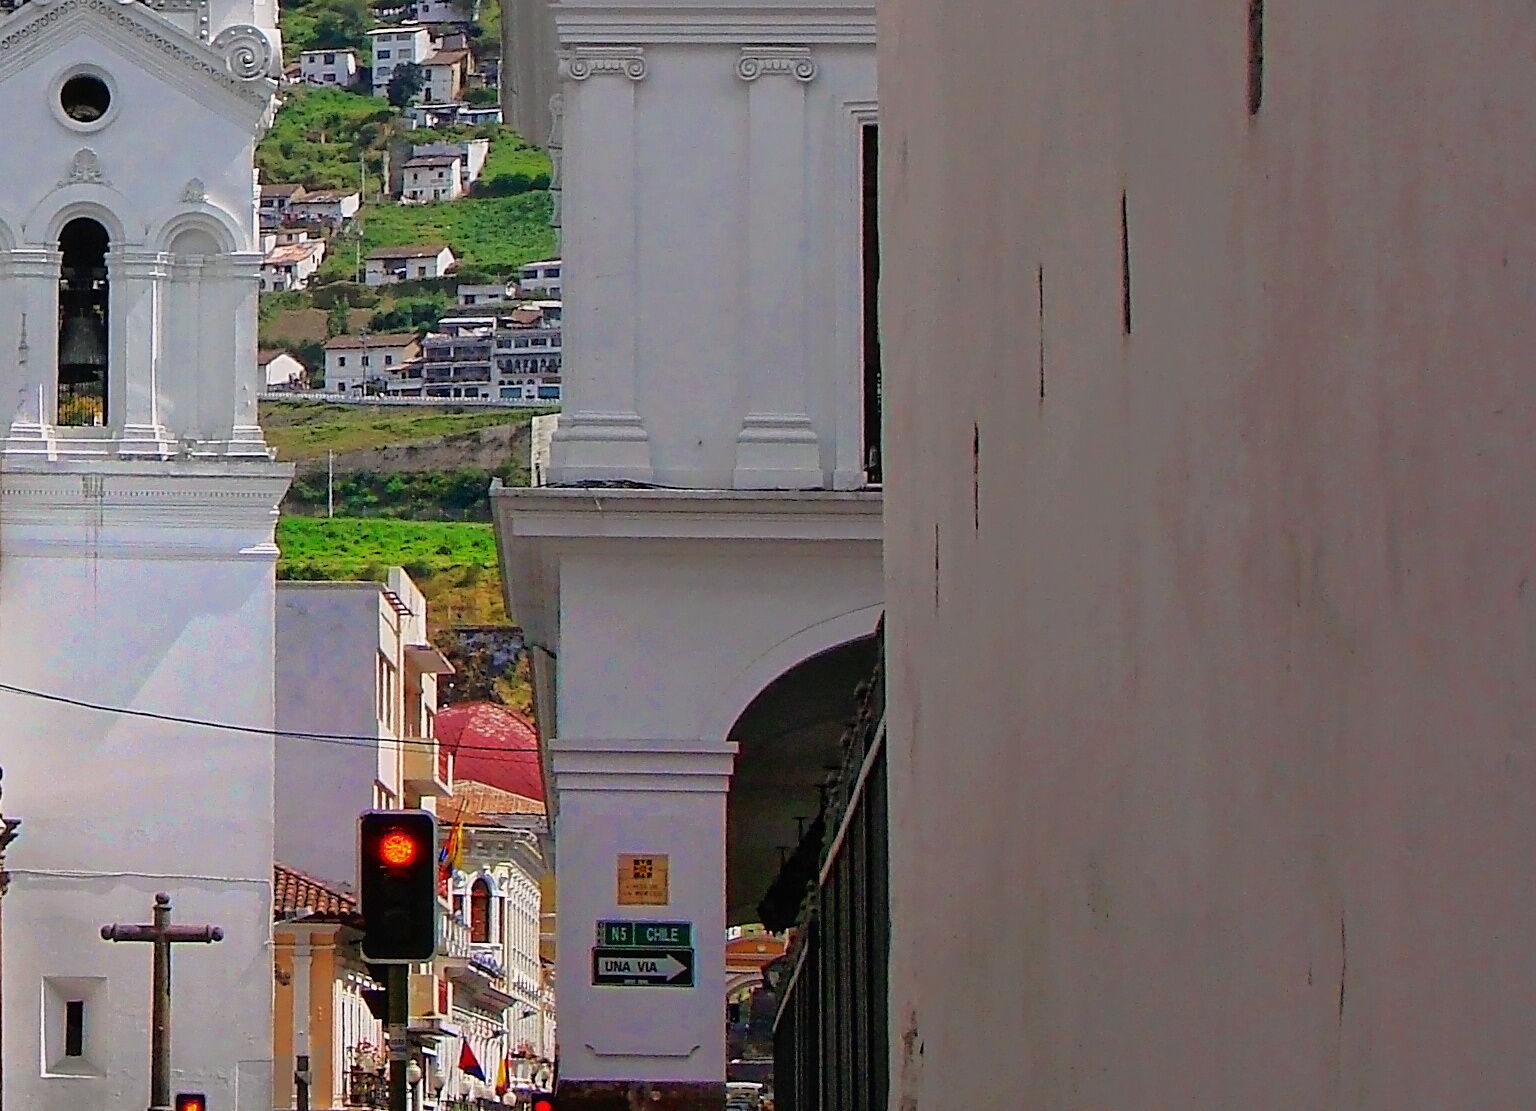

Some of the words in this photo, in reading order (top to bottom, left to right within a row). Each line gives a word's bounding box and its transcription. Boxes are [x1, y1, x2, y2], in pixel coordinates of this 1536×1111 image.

[611, 926, 627, 942] N5
[646, 927, 679, 942] CHILE
[605, 960, 631, 972] UNA
[637, 961, 658, 973] VIA
